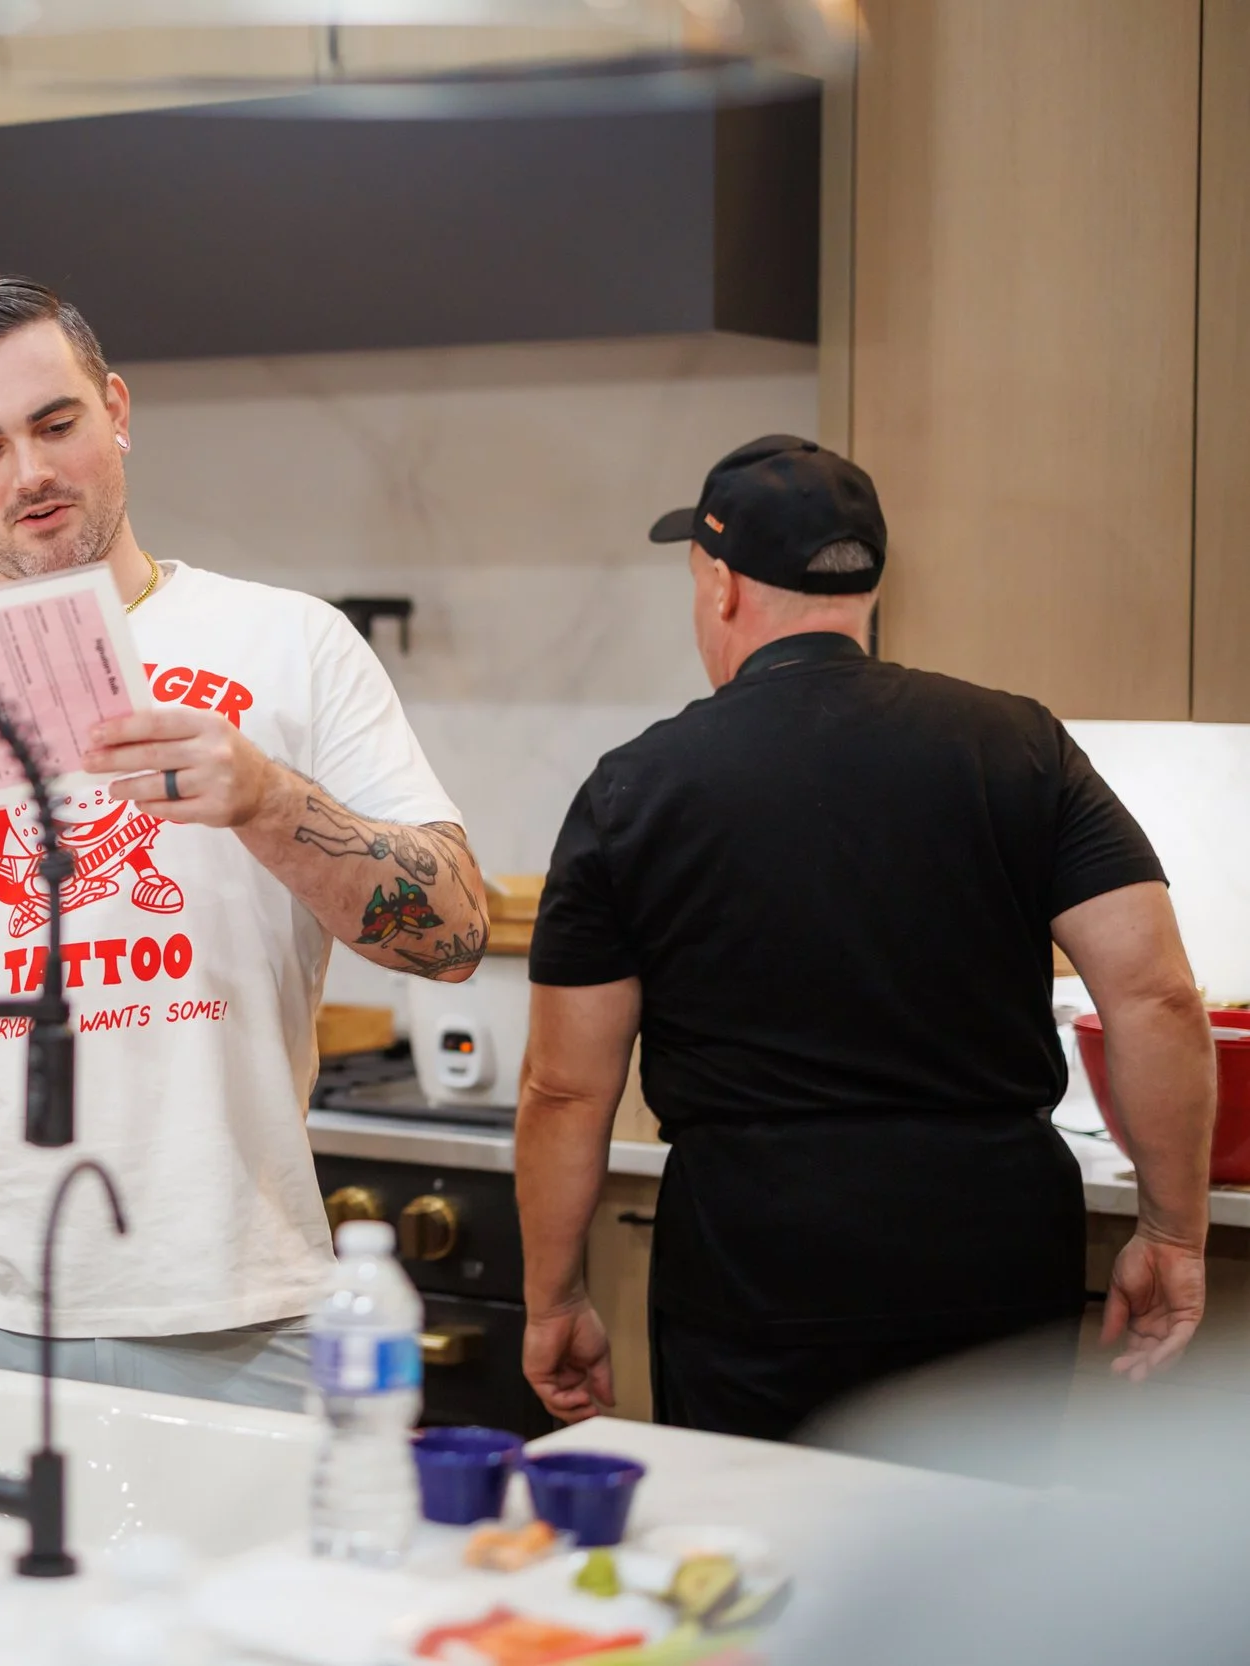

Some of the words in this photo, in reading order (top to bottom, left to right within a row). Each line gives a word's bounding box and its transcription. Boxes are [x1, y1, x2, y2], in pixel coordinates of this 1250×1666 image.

[142, 663, 253, 730] GER
[4, 934, 193, 994] TATTOO
[80, 1005, 151, 1032] WANTS
[166, 1000, 228, 1022] SOME!
